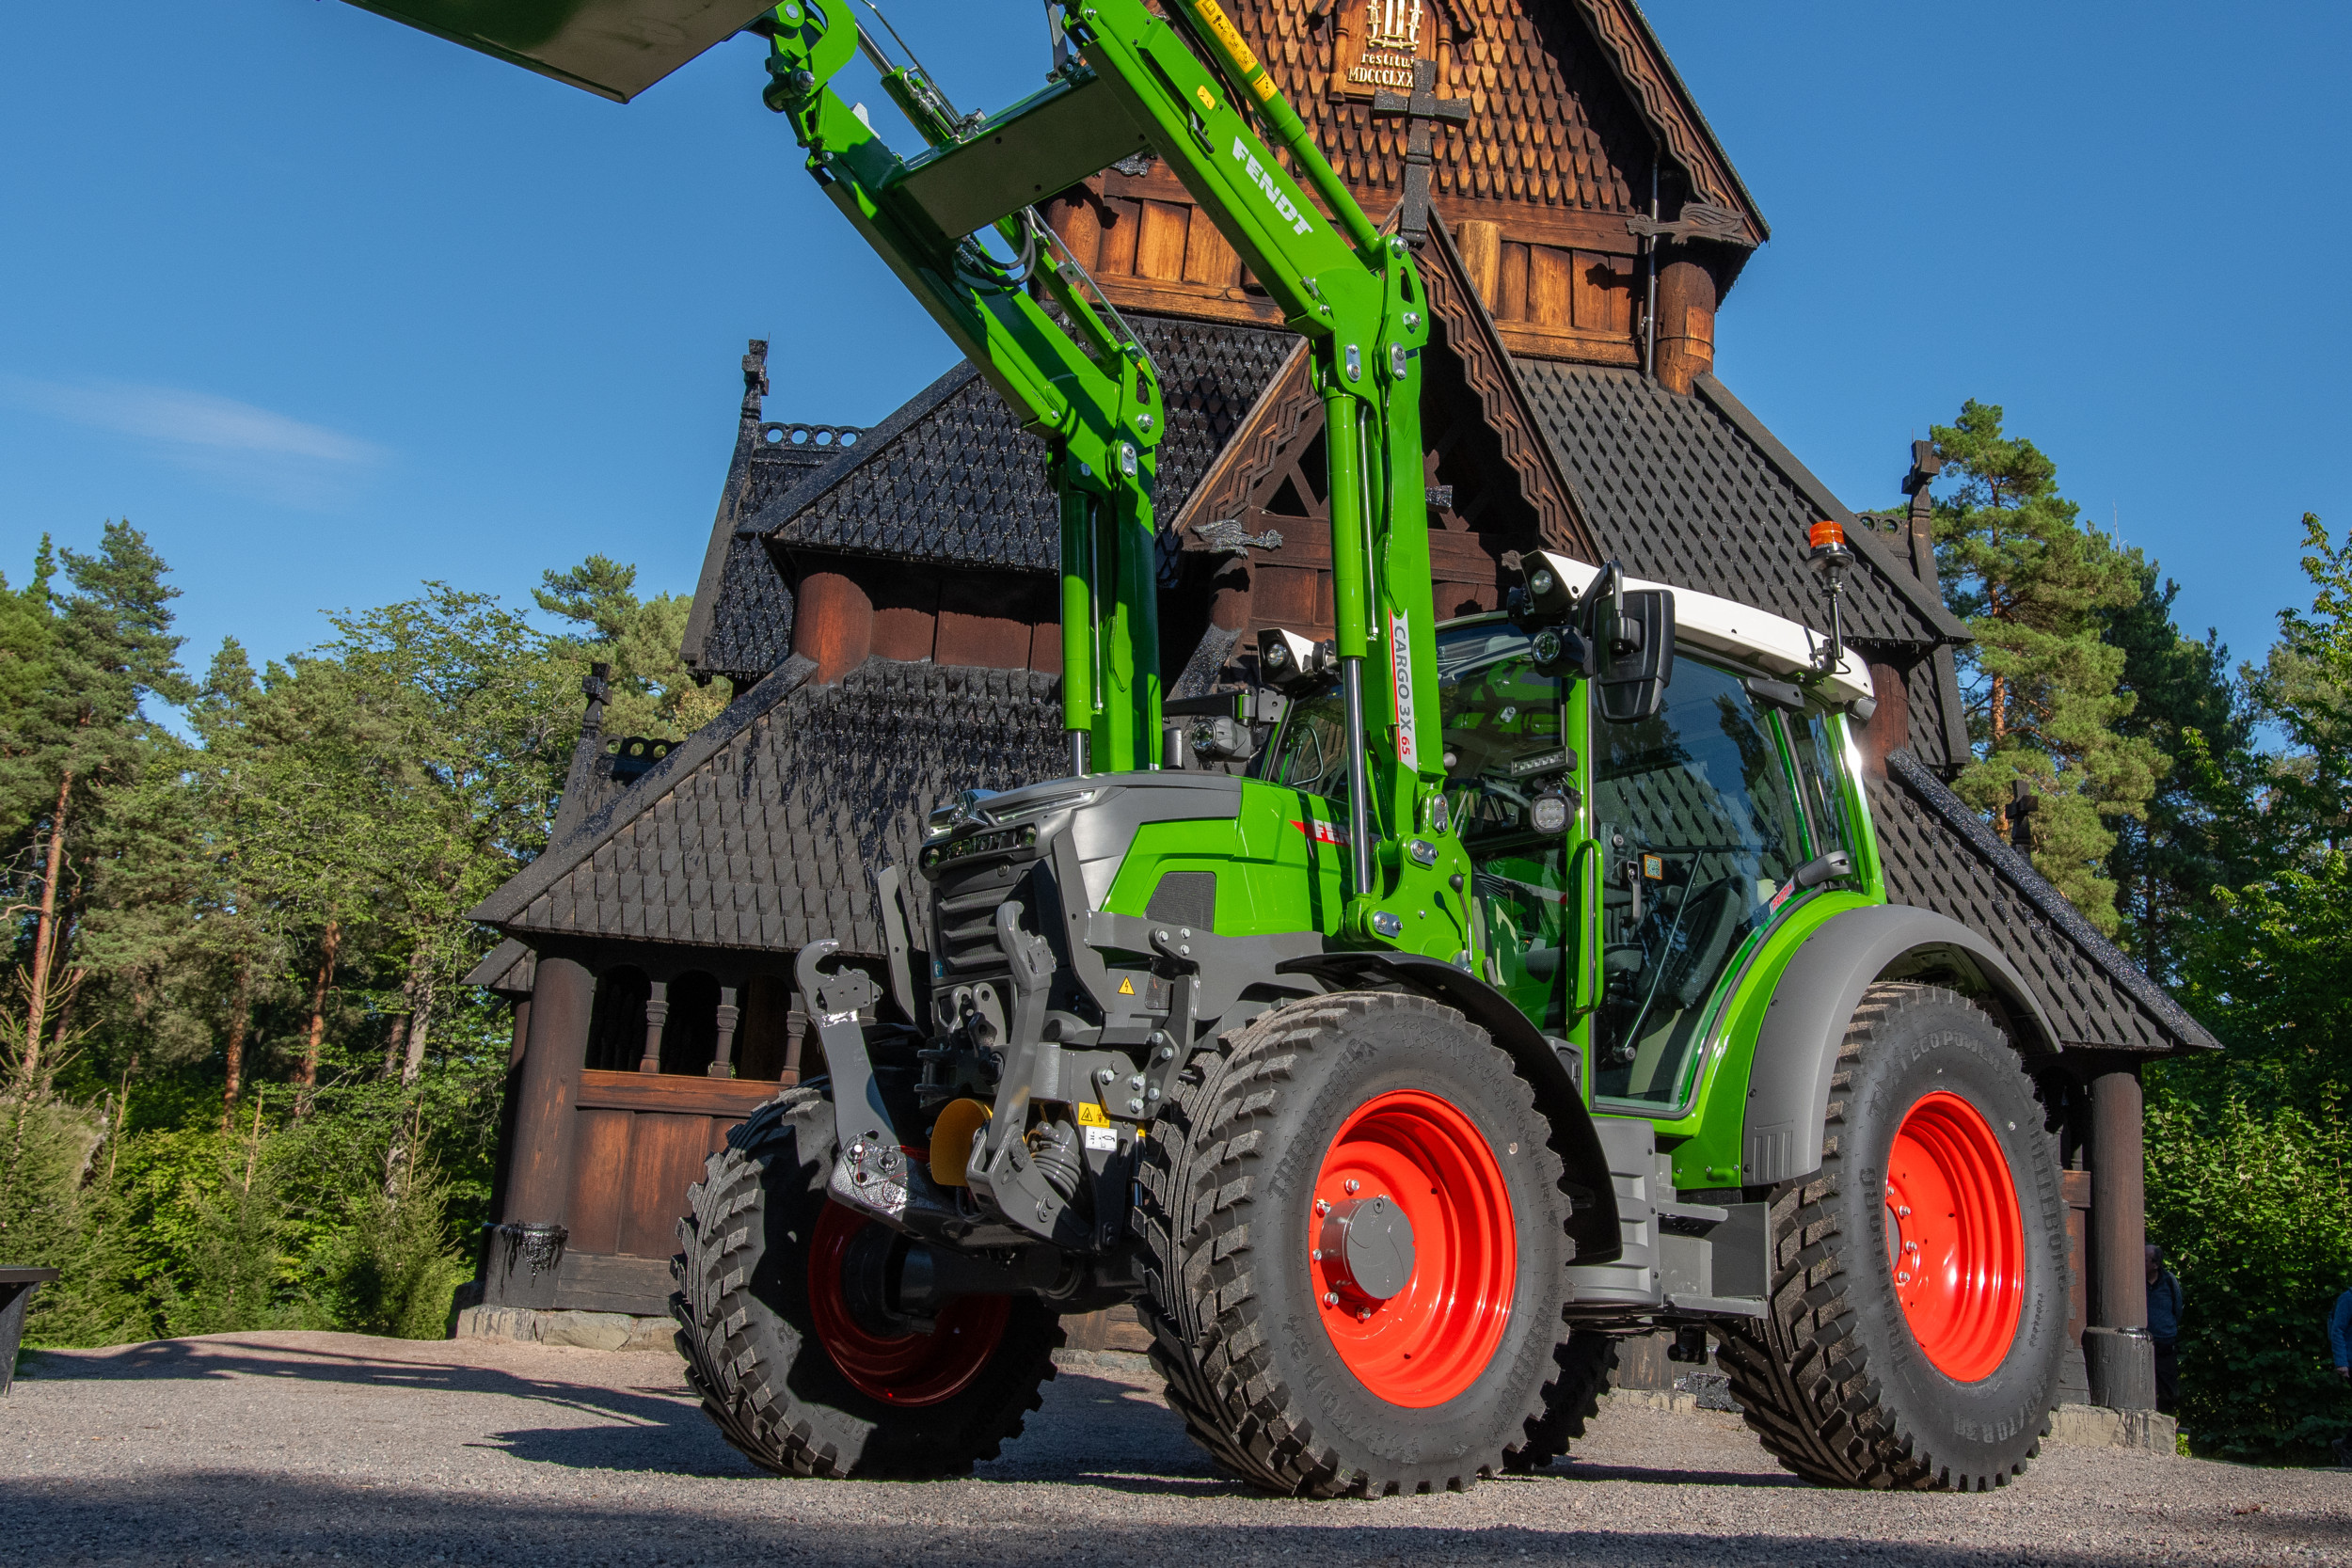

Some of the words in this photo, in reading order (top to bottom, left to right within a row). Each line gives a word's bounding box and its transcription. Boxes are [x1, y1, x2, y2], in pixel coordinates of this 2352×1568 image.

[1232, 135, 1313, 235] FENDT
[1394, 626, 1409, 700] CARGO
[1400, 705, 1411, 731] 3X
[1401, 736, 1410, 755] 65
[1313, 819, 1381, 850] FENT
[1909, 1033, 1940, 1062] ECO
